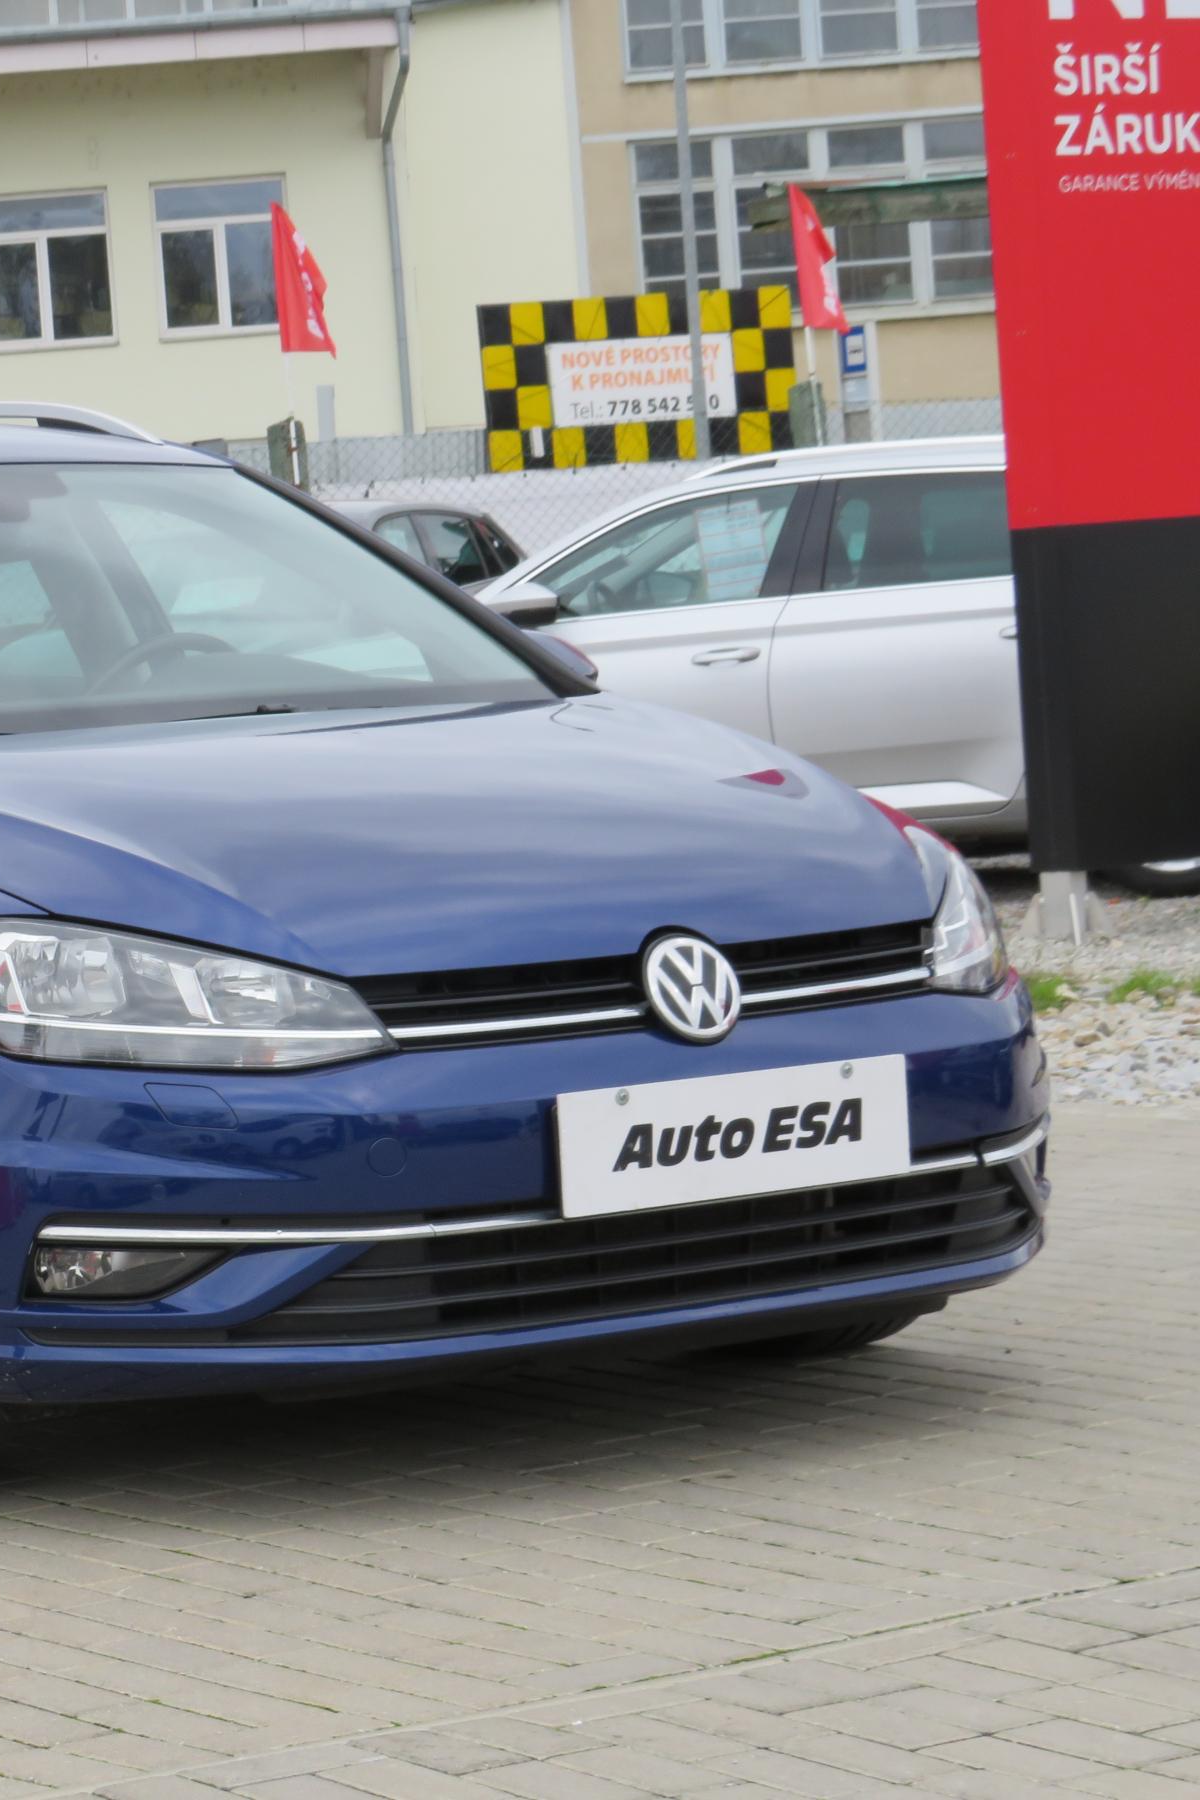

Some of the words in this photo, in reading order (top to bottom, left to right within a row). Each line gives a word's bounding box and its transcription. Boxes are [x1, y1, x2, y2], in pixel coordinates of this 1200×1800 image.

[1053, 42, 1161, 96] ŠIRŠÍ
[1058, 172, 1141, 193] GARANCE
[561, 345, 616, 369] NOVÉ
[572, 373, 584, 391] K
[589, 363, 716, 391] PRONAJMUÍ
[608, 400, 642, 417] 778
[648, 396, 680, 414] 542
[686, 394, 720, 411] 50
[612, 1114, 756, 1173] Auto
[762, 1097, 862, 1154] ESA
